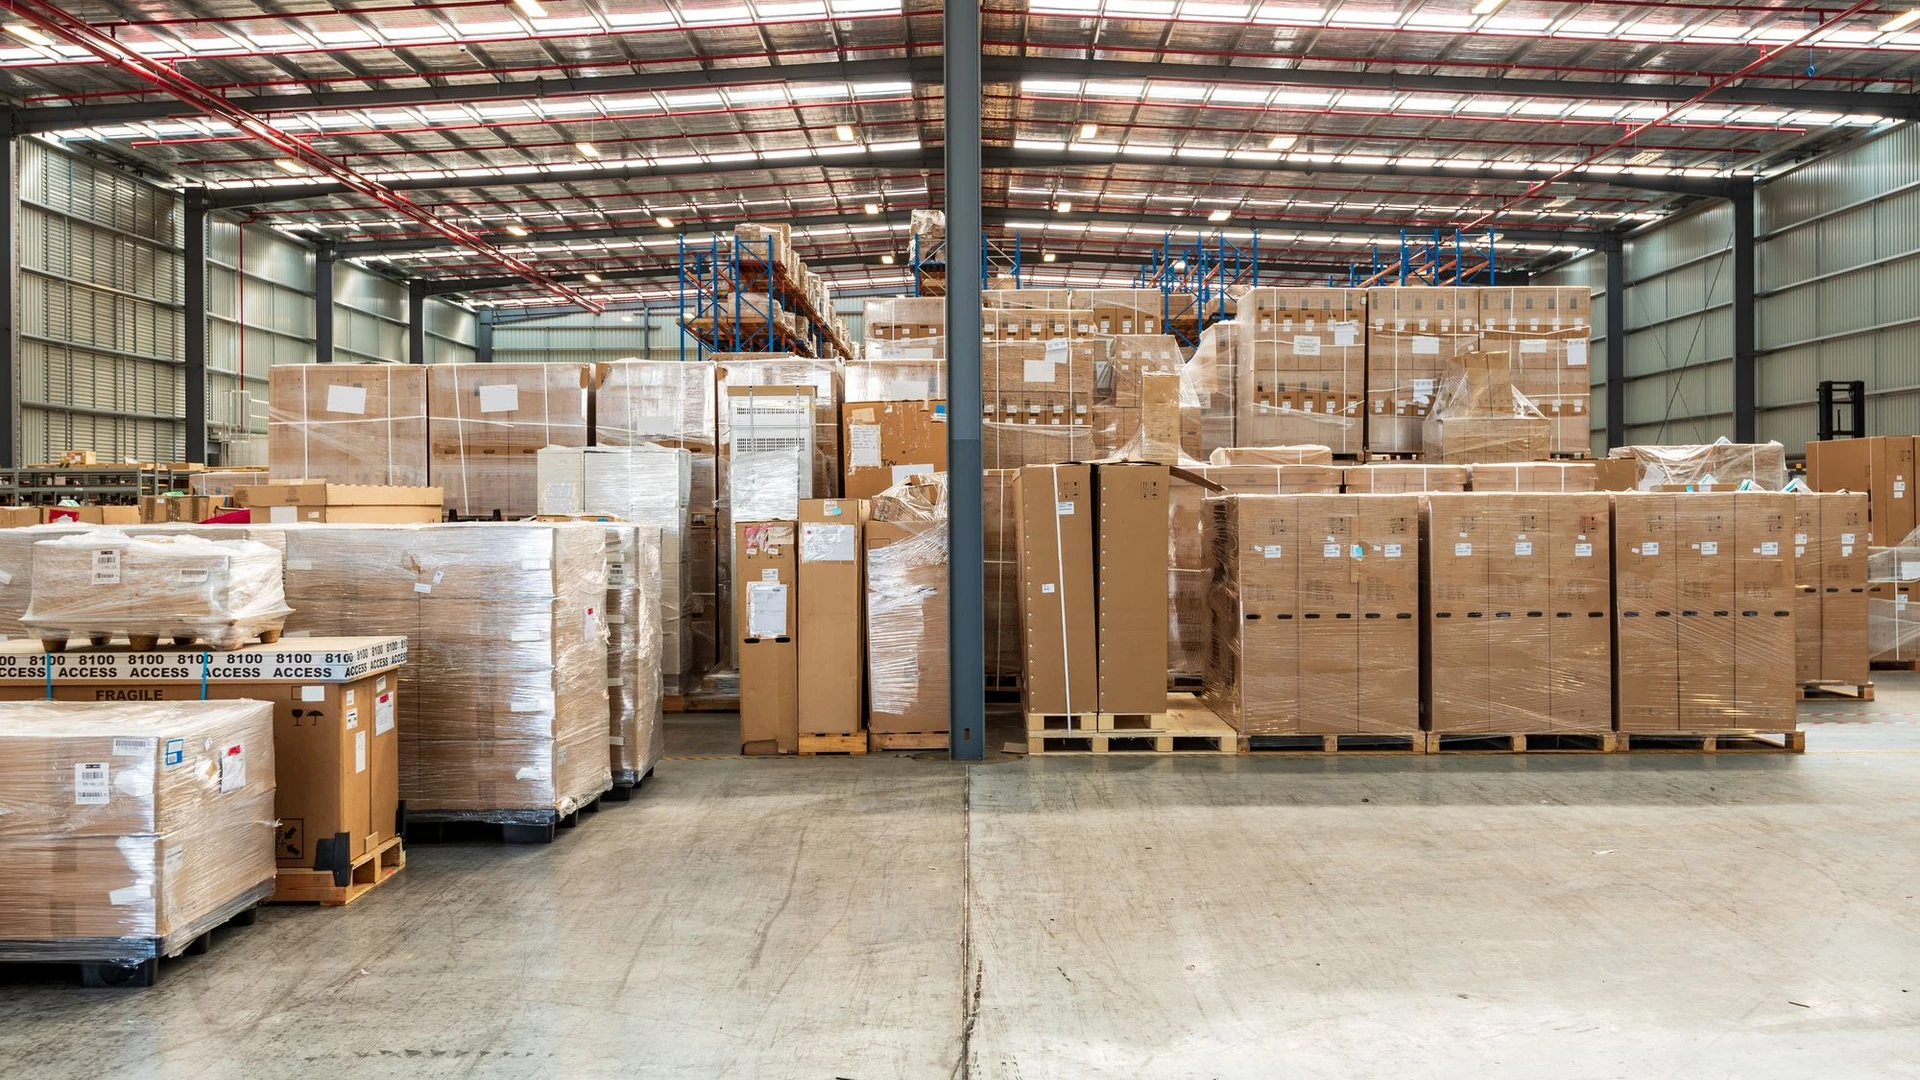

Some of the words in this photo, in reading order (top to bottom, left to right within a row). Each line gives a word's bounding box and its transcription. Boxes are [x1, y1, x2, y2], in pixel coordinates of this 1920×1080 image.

[29, 656, 66, 666] 8100
[78, 655, 115, 665] 8100
[128, 655, 164, 665] 8100
[177, 654, 214, 665] 8100
[226, 654, 263, 664] 8100
[276, 653, 312, 664] 8100
[58, 667, 118, 678] ACCESS
[130, 667, 189, 678] ACCESS
[273, 667, 332, 678] ACCESS
[344, 662, 368, 677] ACCESS
[96, 689, 163, 701] FRAGILE
